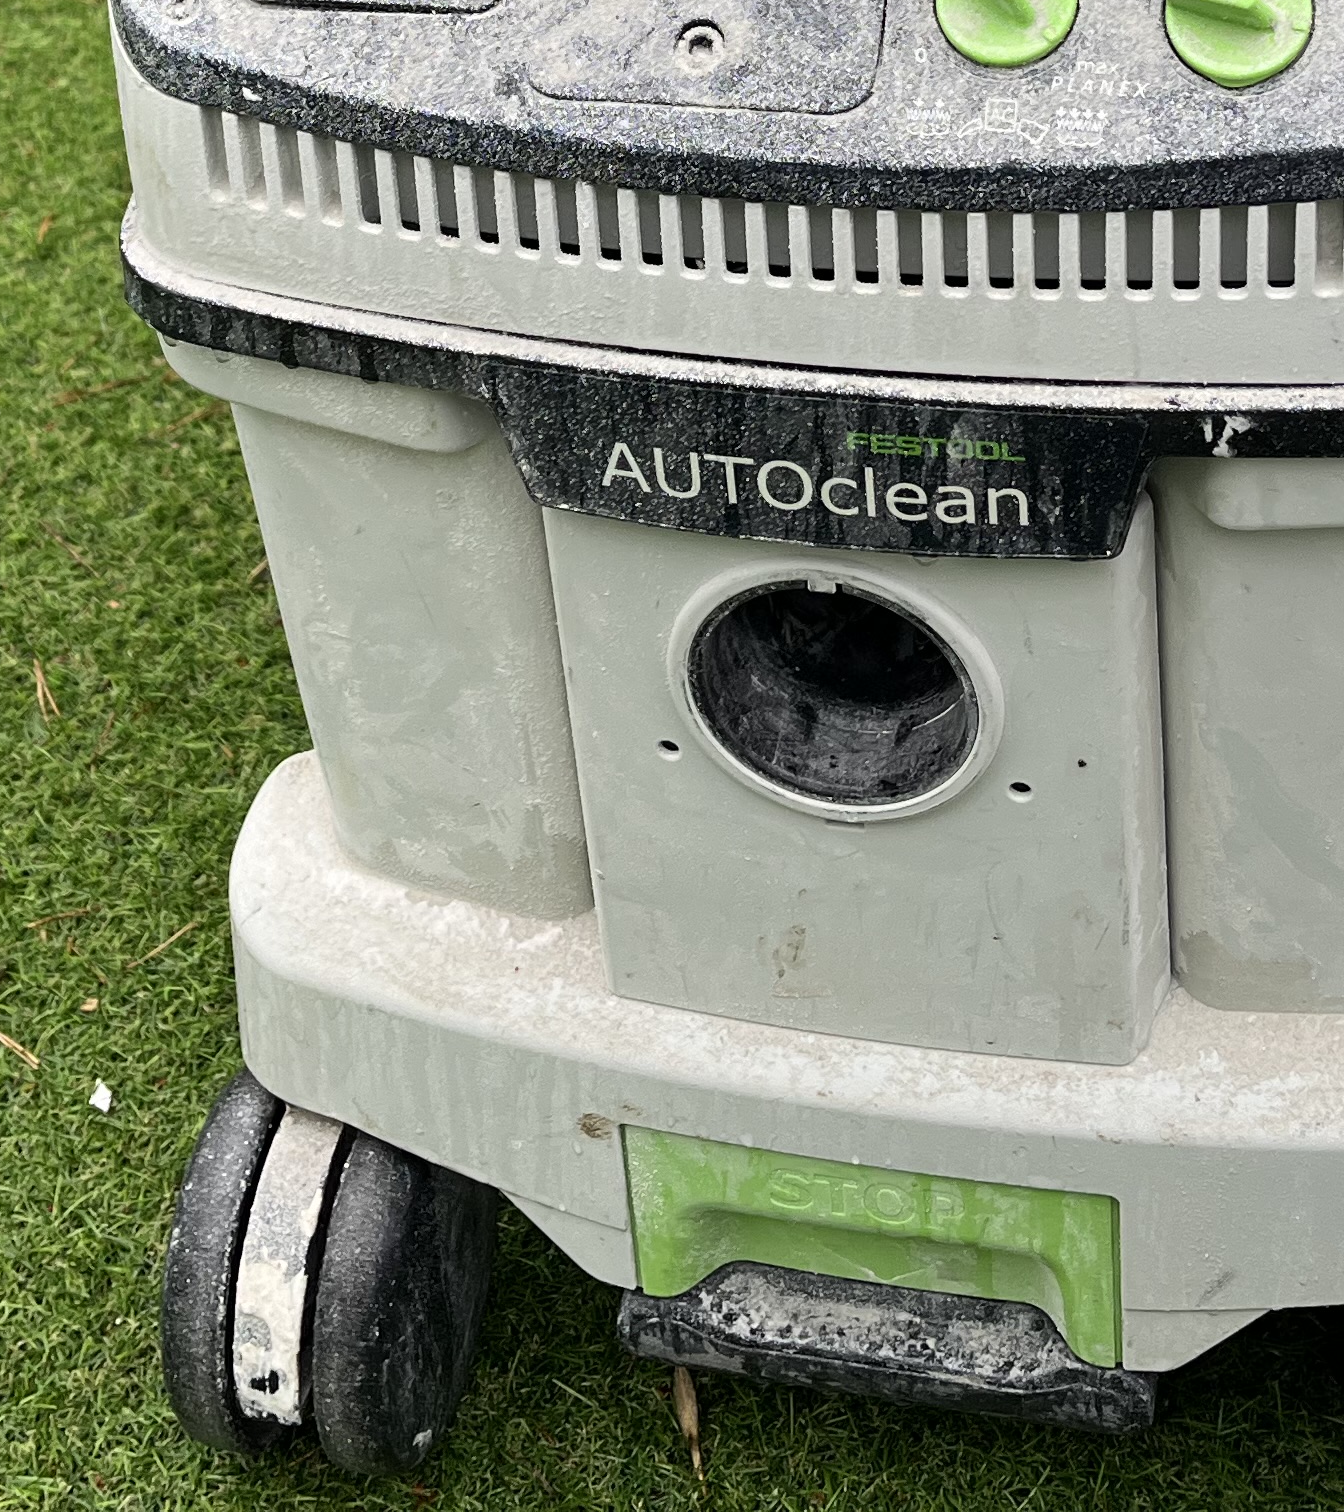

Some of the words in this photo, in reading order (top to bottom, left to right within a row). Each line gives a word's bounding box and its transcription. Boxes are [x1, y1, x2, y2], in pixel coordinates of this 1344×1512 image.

[1076, 60, 1120, 76] max
[1050, 75, 1151, 99] PLANEX
[845, 431, 1027, 462] FESTOOL
[600, 441, 1030, 526] AUTOclean
[769, 1167, 967, 1231] STOP
